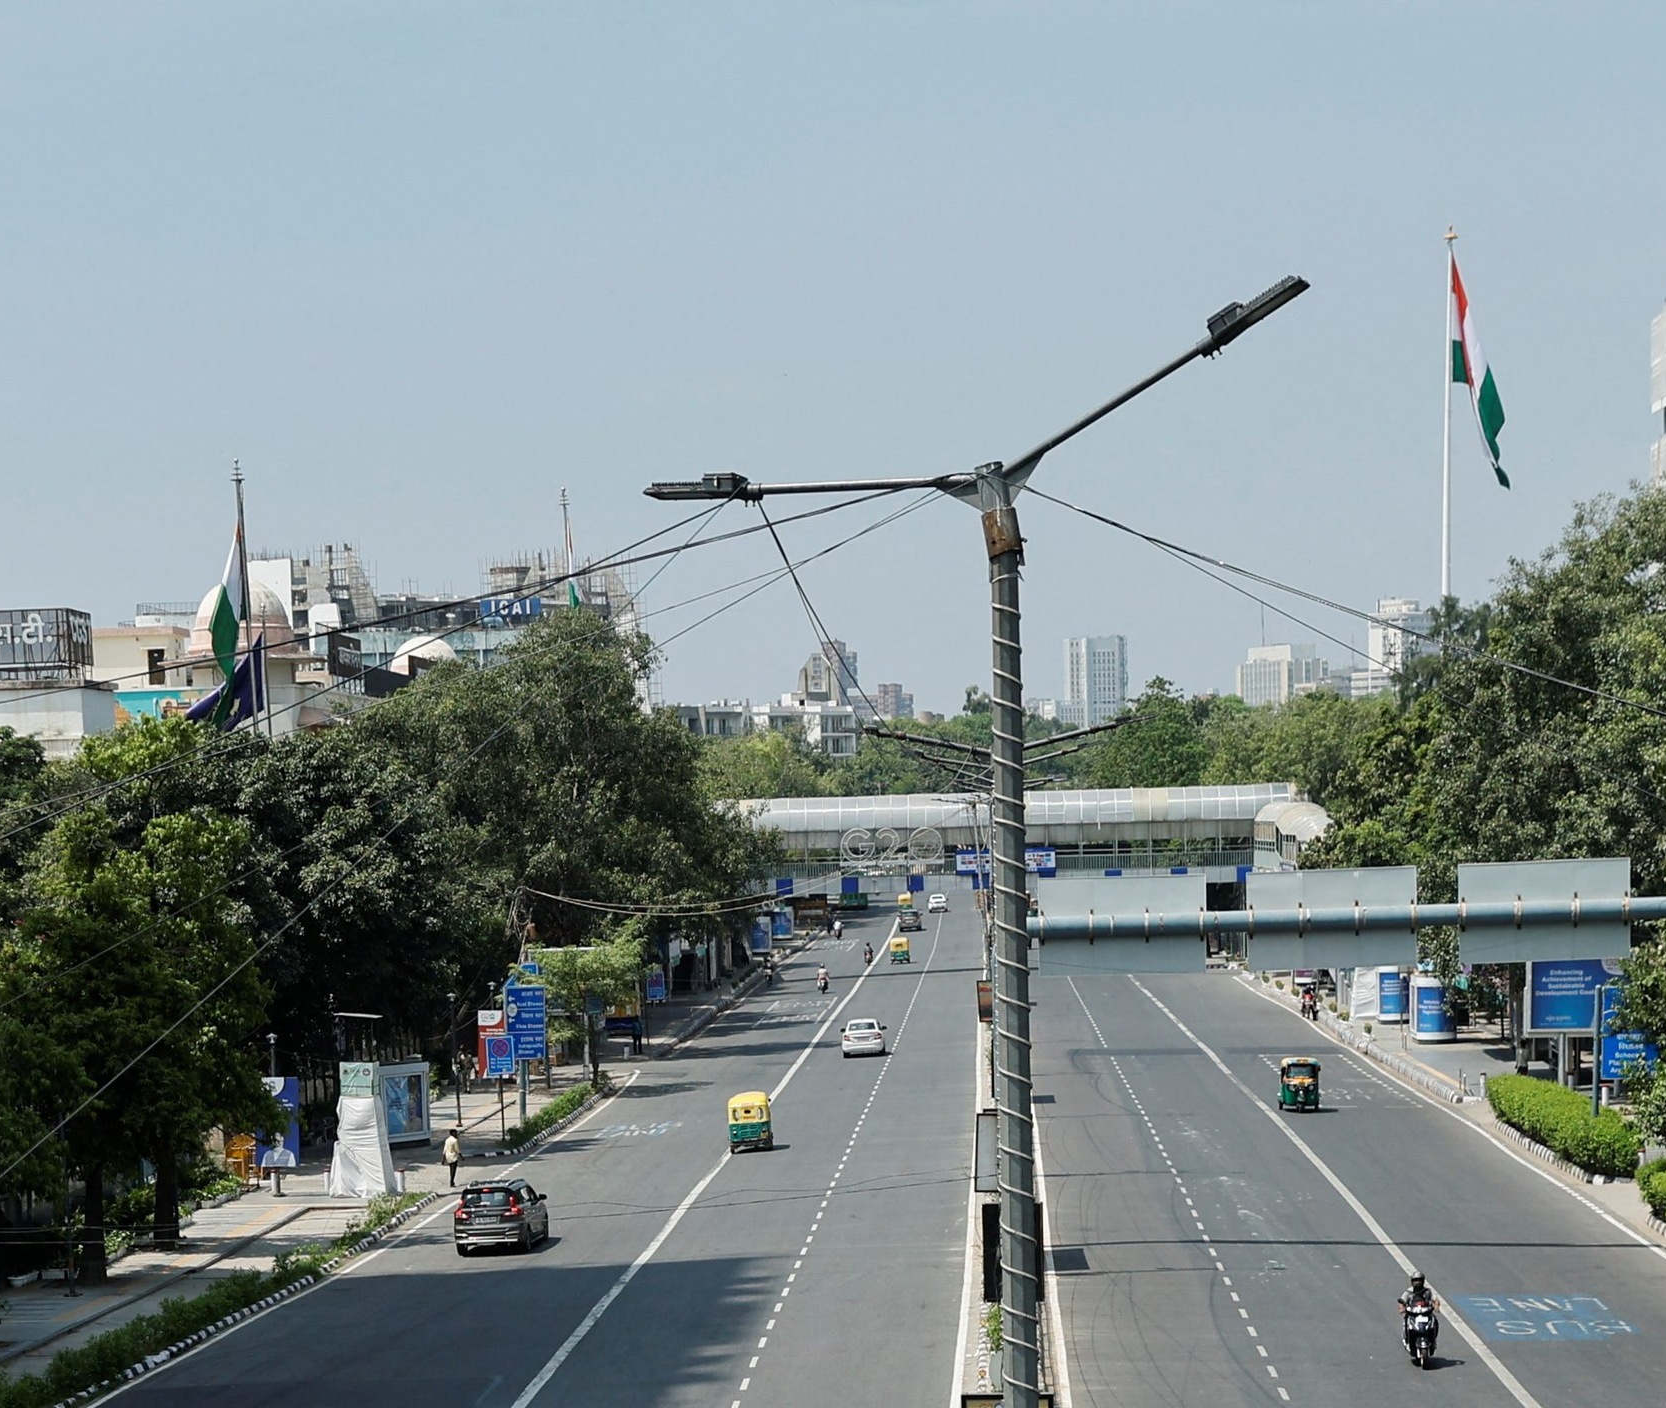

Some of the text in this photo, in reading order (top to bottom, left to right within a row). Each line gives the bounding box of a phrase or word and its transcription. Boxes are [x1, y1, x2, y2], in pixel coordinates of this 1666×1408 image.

[490, 598, 531, 616] ICAI
[840, 826, 943, 864] G20
[1541, 975, 1583, 983] Achievement
[1547, 982, 1585, 990] Sustainable
[1579, 988, 1595, 996] Goal
